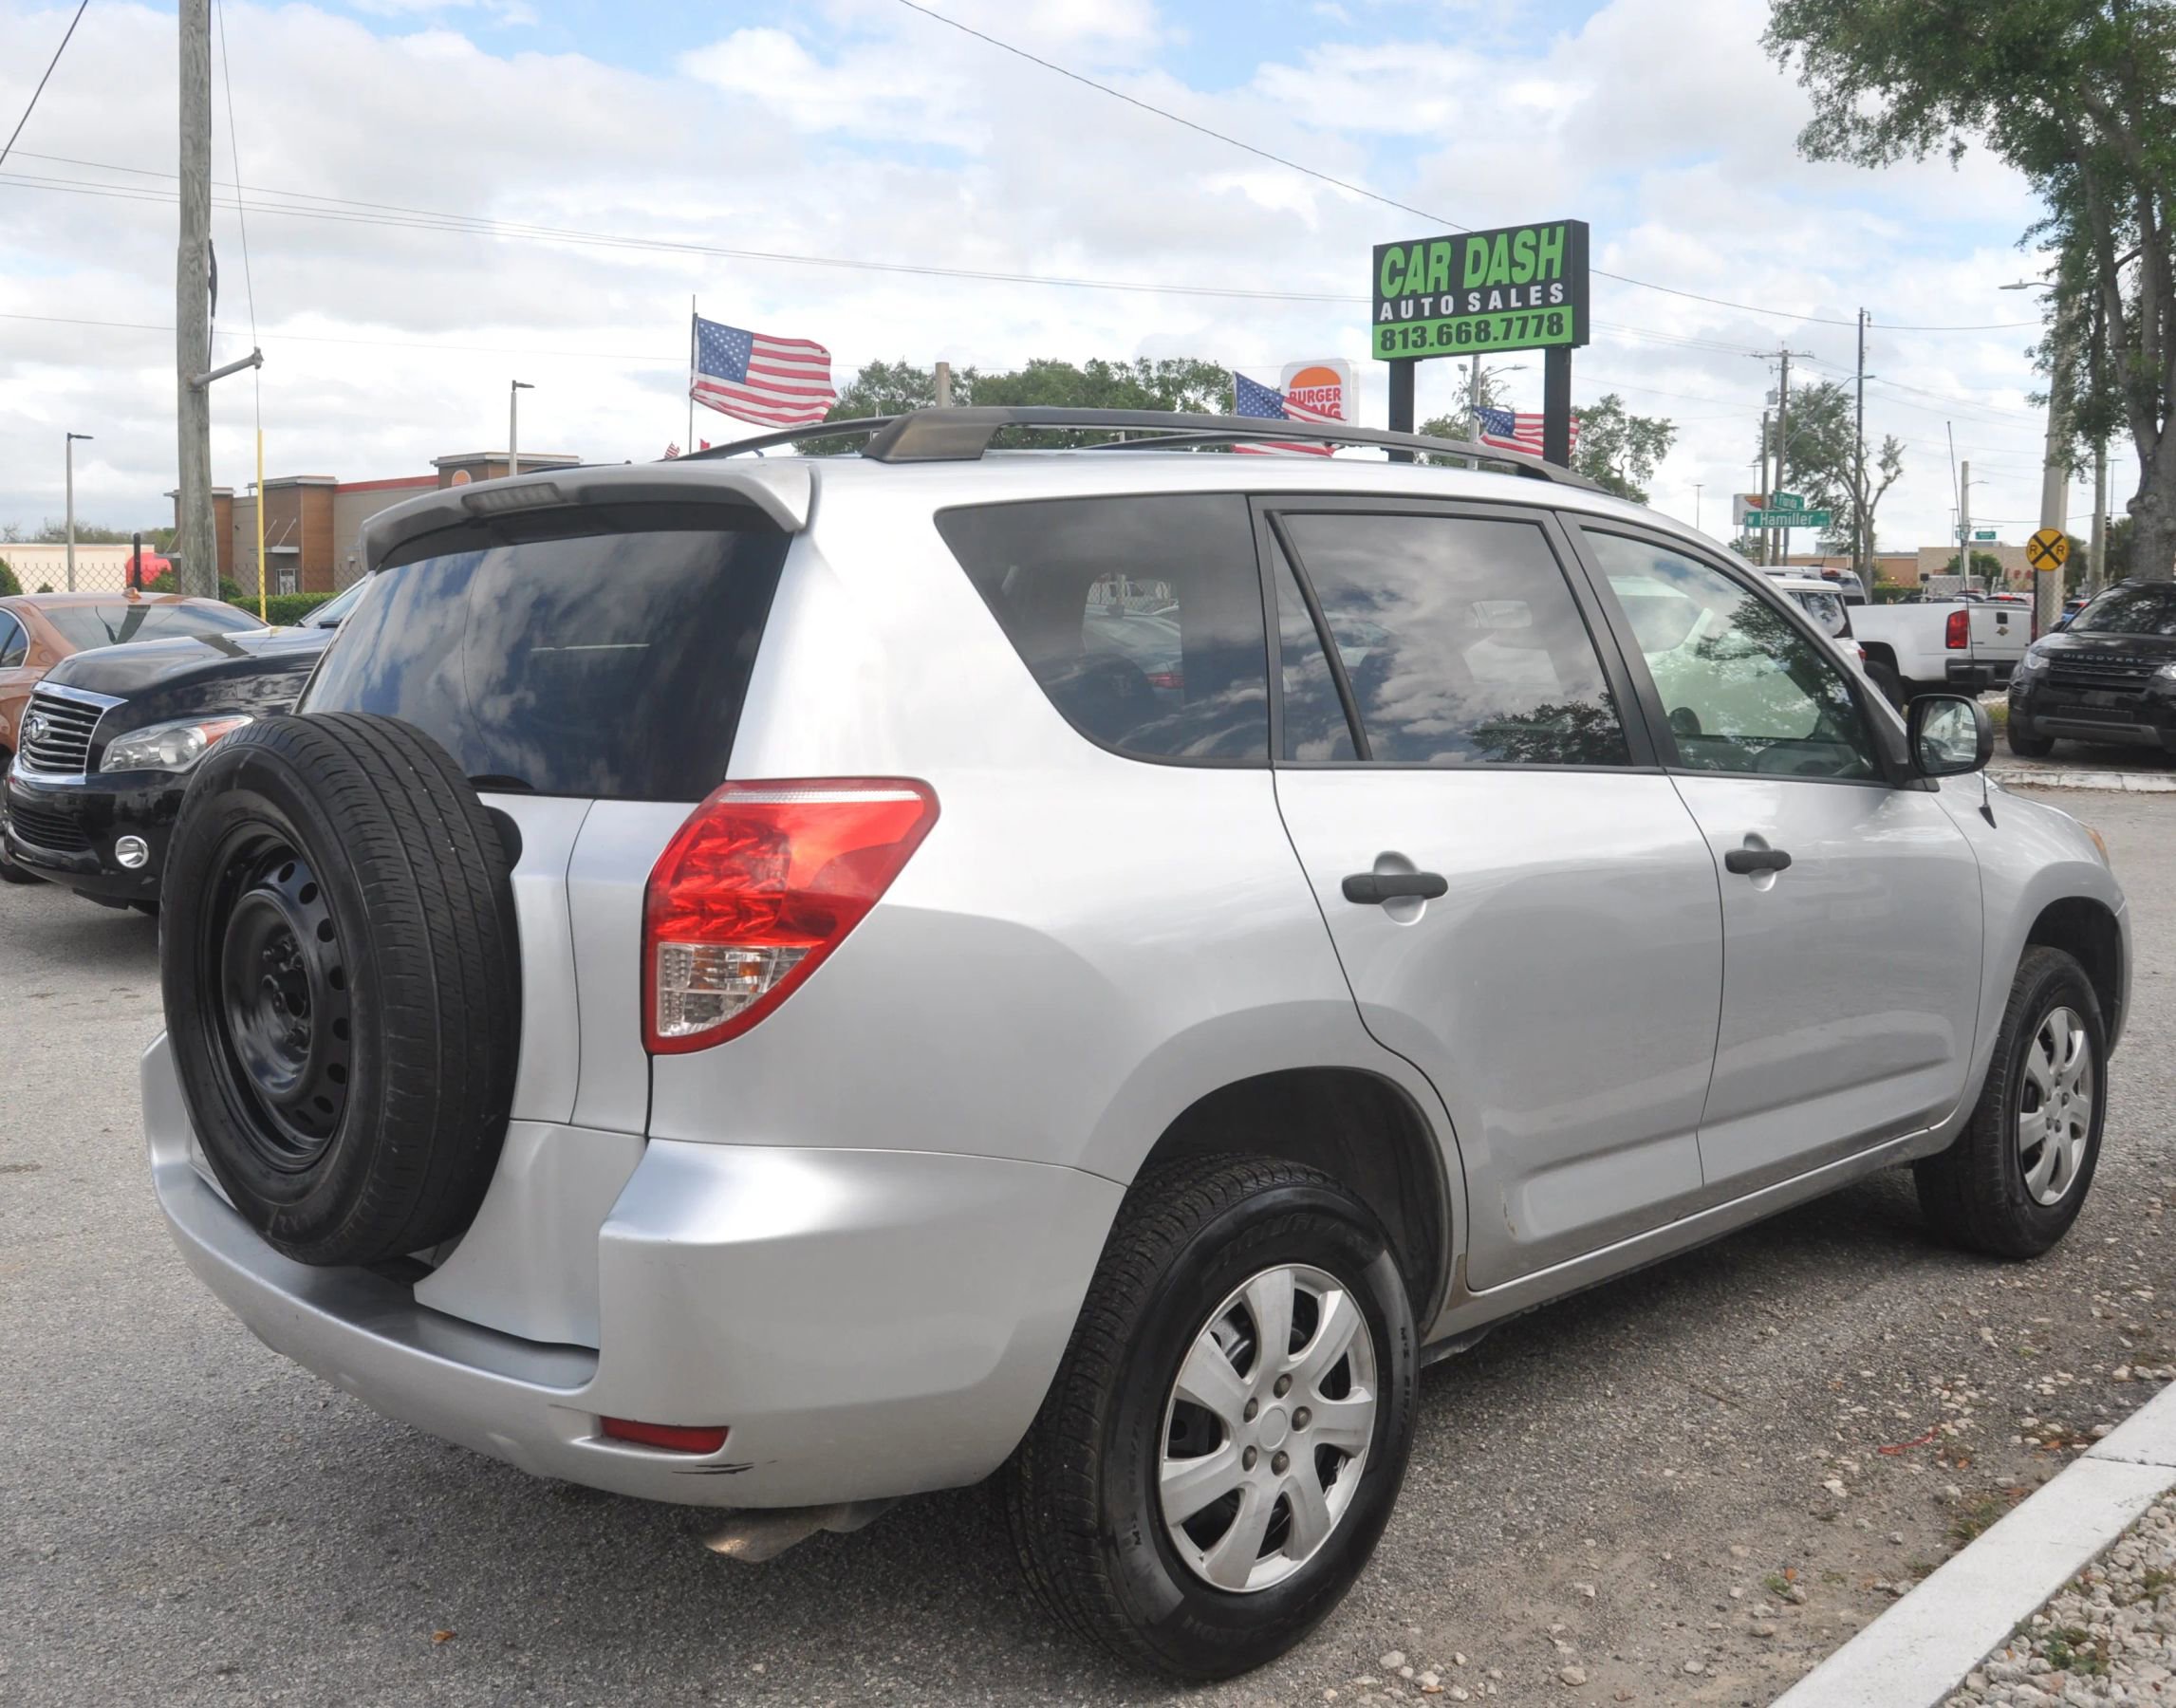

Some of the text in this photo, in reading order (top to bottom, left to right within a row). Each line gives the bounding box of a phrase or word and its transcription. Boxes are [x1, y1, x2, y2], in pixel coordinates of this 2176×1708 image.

[1380, 225, 1565, 299] CAR DASH
[1379, 283, 1564, 322] AUTO SALES
[1380, 311, 1565, 352] 813.668.7778
[1747, 515, 1755, 525] W
[1759, 512, 1813, 526] Hamiller
[2029, 545, 2065, 555] R R
[2063, 653, 2145, 663] DISCOVERY
